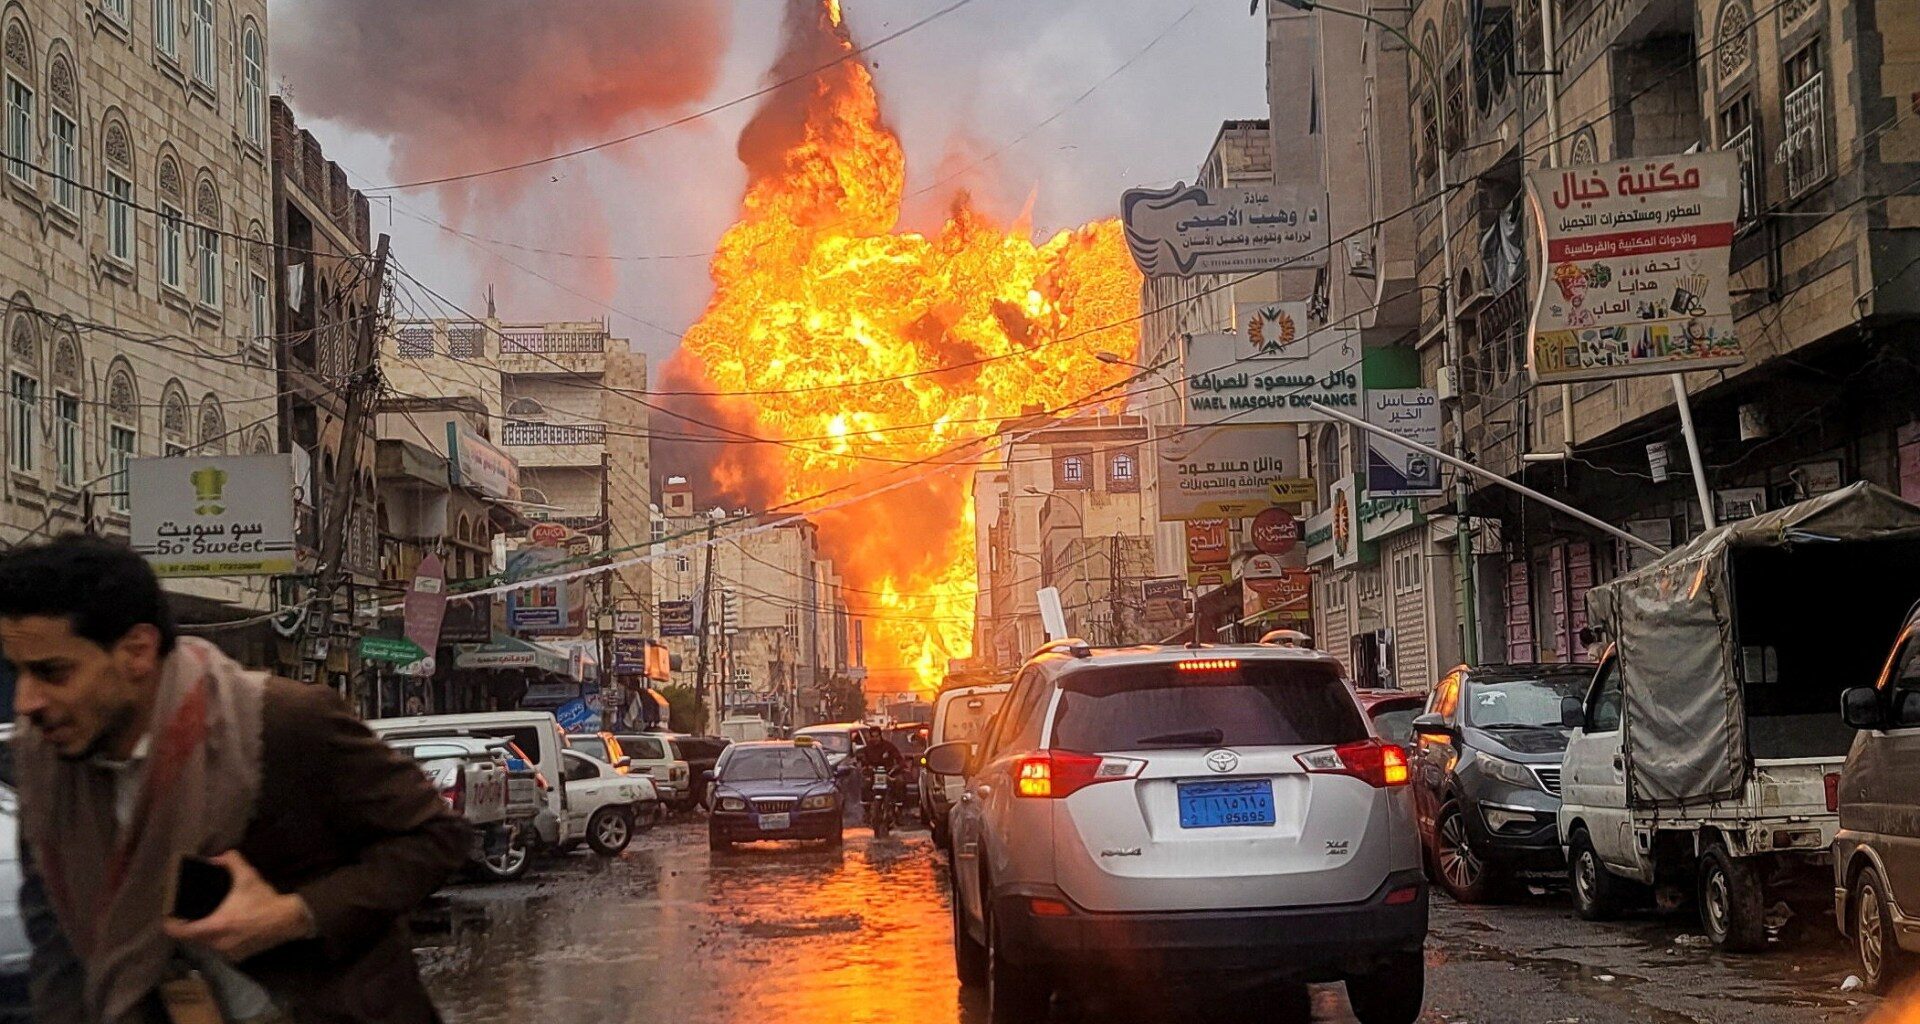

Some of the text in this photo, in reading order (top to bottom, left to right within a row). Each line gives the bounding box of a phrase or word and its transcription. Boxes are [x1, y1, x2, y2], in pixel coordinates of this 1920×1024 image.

[1552, 163, 1700, 209] مكتبة خيال
[1249, 208, 1297, 228] وهيب
[1559, 204, 1701, 232] للعطور ومستحضرات التجميل
[1564, 240, 1616, 255] والقرطاسية
[1619, 236, 1656, 250] المكتبية
[1644, 257, 1680, 273] تحف
[1617, 280, 1658, 296] هدايا
[1190, 370, 1357, 394] وائل مسعود للصرافة
[1190, 393, 1358, 411] WAEL MASOUD EXCHANGE
[1376, 393, 1435, 409] مغاسل
[1388, 408, 1422, 423] الخير
[1178, 460, 1249, 477] مسعود
[1179, 478, 1236, 491] والتحويلات
[157, 521, 263, 543] سو سويت
[156, 539, 264, 555] So Sweet
